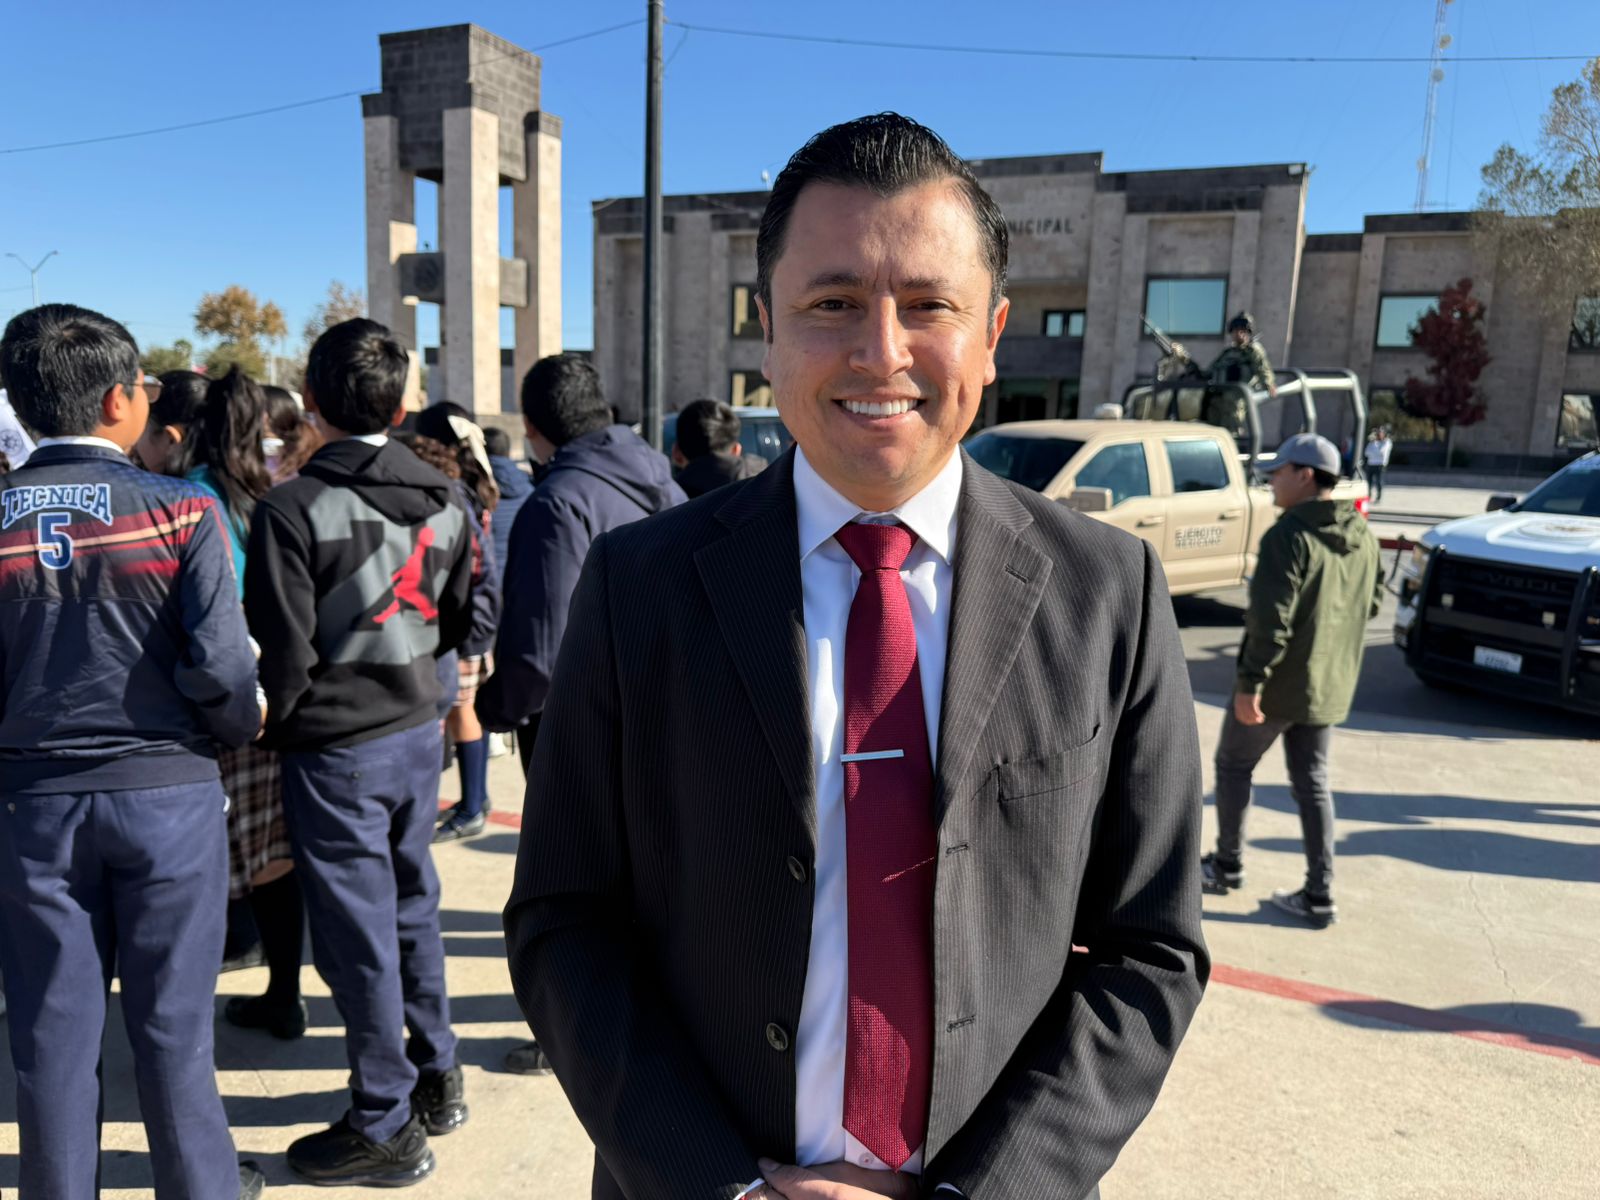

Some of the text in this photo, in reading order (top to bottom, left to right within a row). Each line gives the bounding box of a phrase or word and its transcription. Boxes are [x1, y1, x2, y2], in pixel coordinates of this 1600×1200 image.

[1007, 217, 1074, 235] NICIPAL
[2, 483, 113, 529] TECNICA
[38, 512, 73, 570] 5
